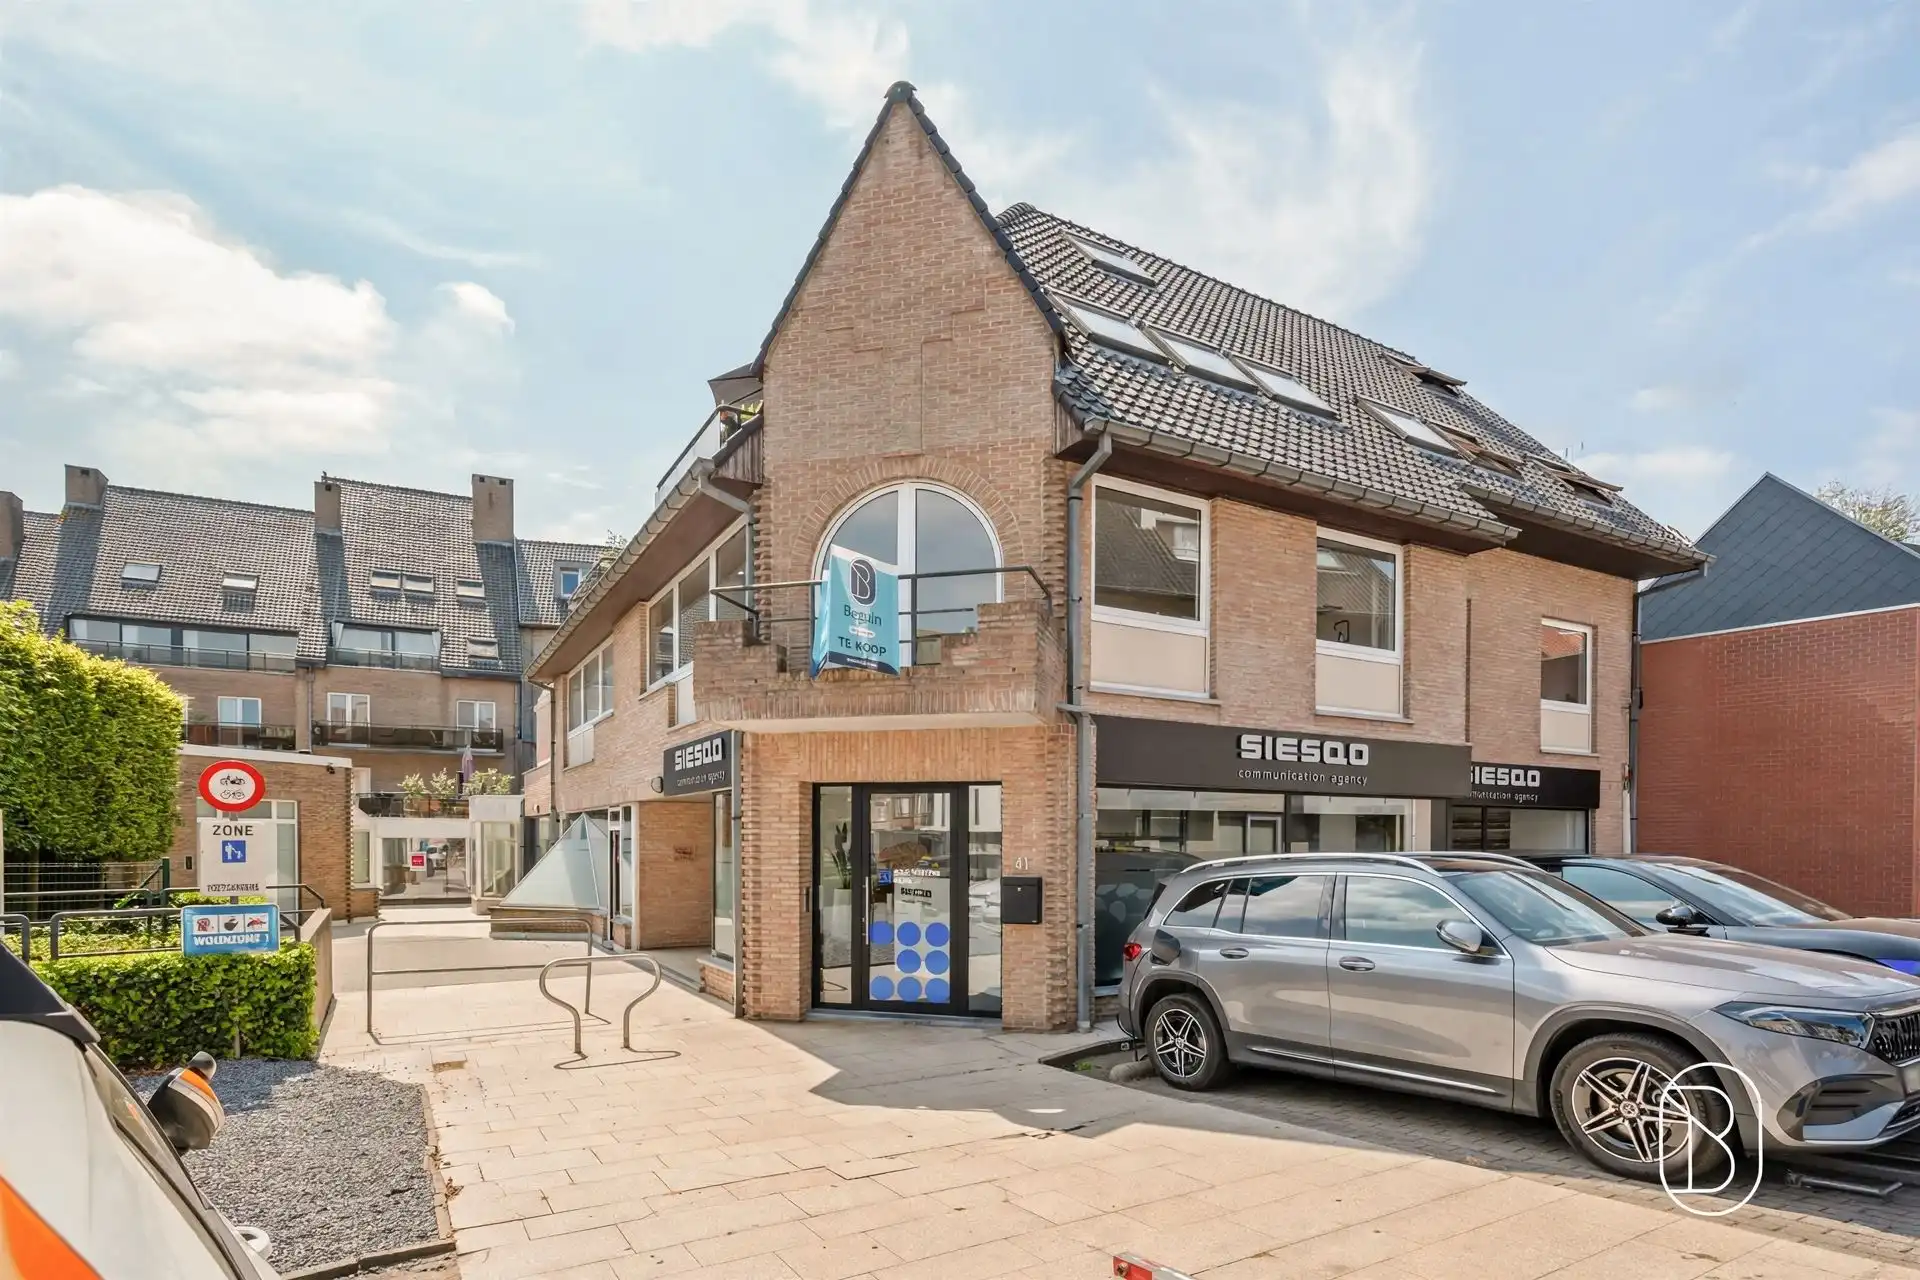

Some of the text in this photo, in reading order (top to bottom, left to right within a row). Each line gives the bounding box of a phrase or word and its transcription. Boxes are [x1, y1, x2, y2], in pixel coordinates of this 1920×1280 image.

[838, 636, 887, 656] TE KOOP
[675, 738, 722, 771] SIESQO
[1240, 734, 1369, 766] SIESQO
[1238, 769, 1368, 786] communication agency
[1470, 766, 1540, 787] IESQO
[212, 824, 254, 836] ZONE
